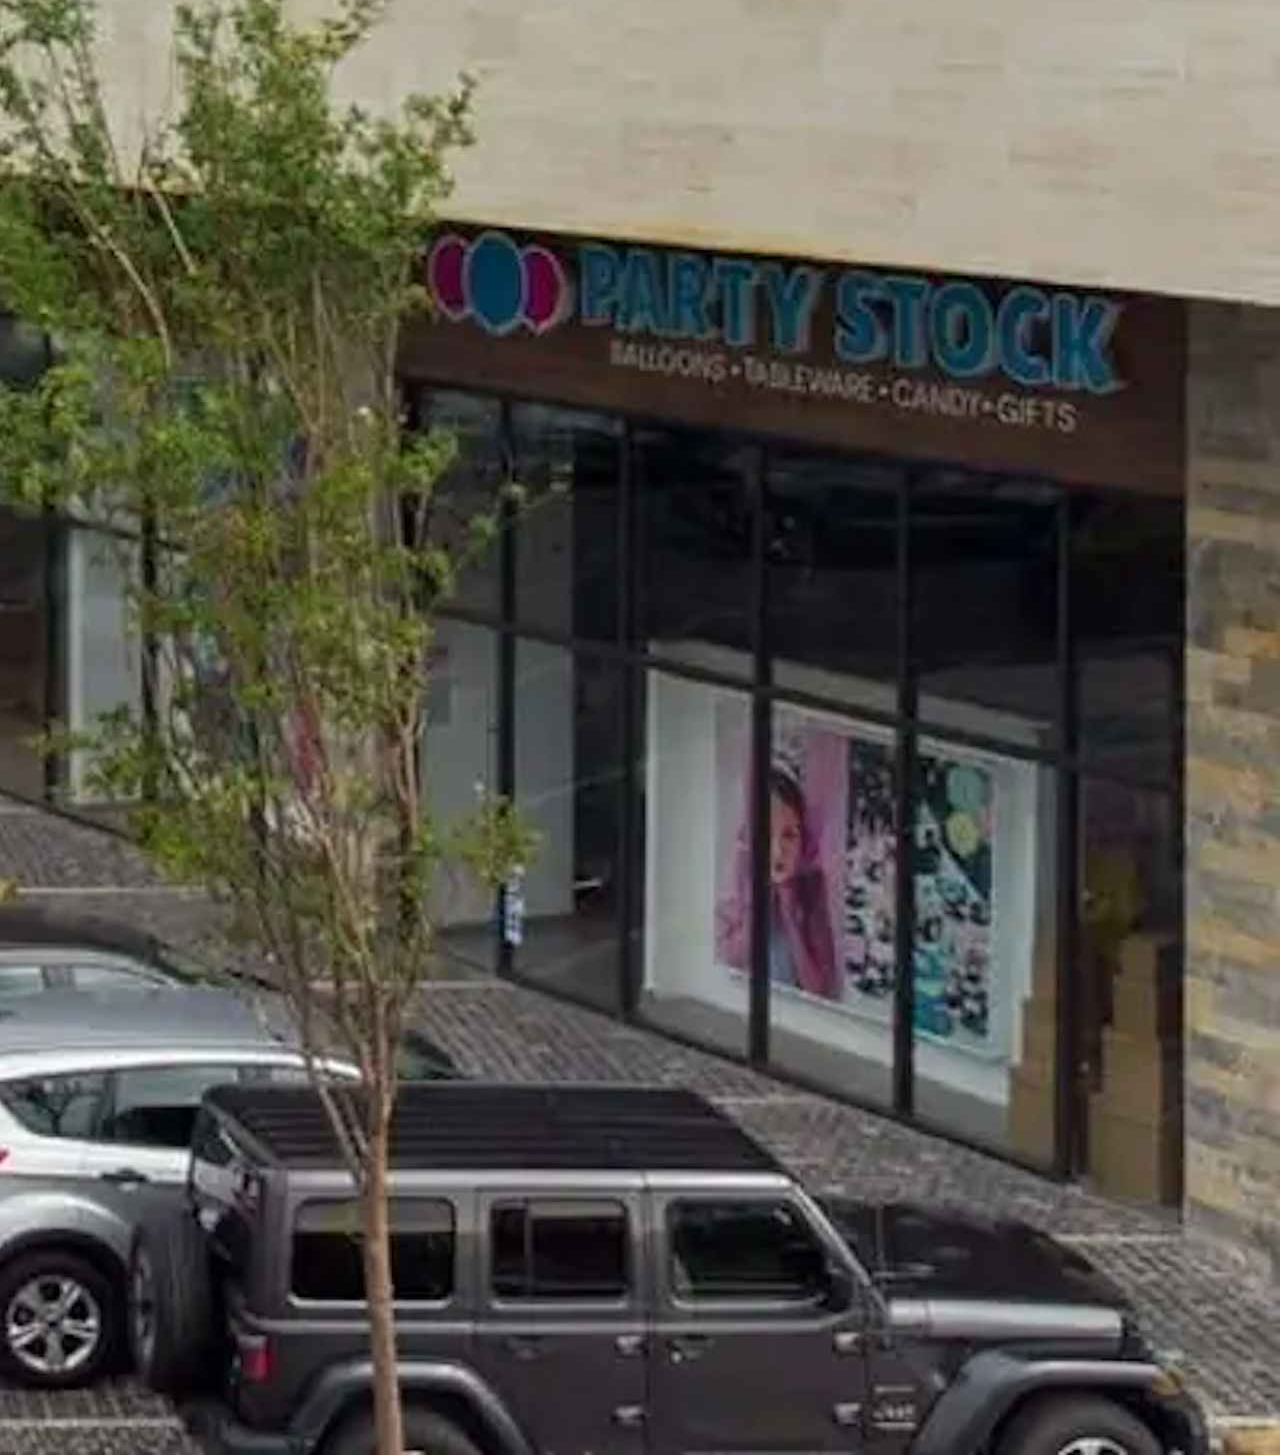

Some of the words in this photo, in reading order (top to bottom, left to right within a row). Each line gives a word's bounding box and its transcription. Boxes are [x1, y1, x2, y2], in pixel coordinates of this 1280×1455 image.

[580, 244, 826, 352] PARTY
[834, 270, 1128, 395] STOCK
[608, 340, 730, 382] BALLOONS
[742, 354, 878, 404] TABLEWARE
[891, 378, 983, 418] CANDY
[996, 392, 1078, 433] GIFTS
